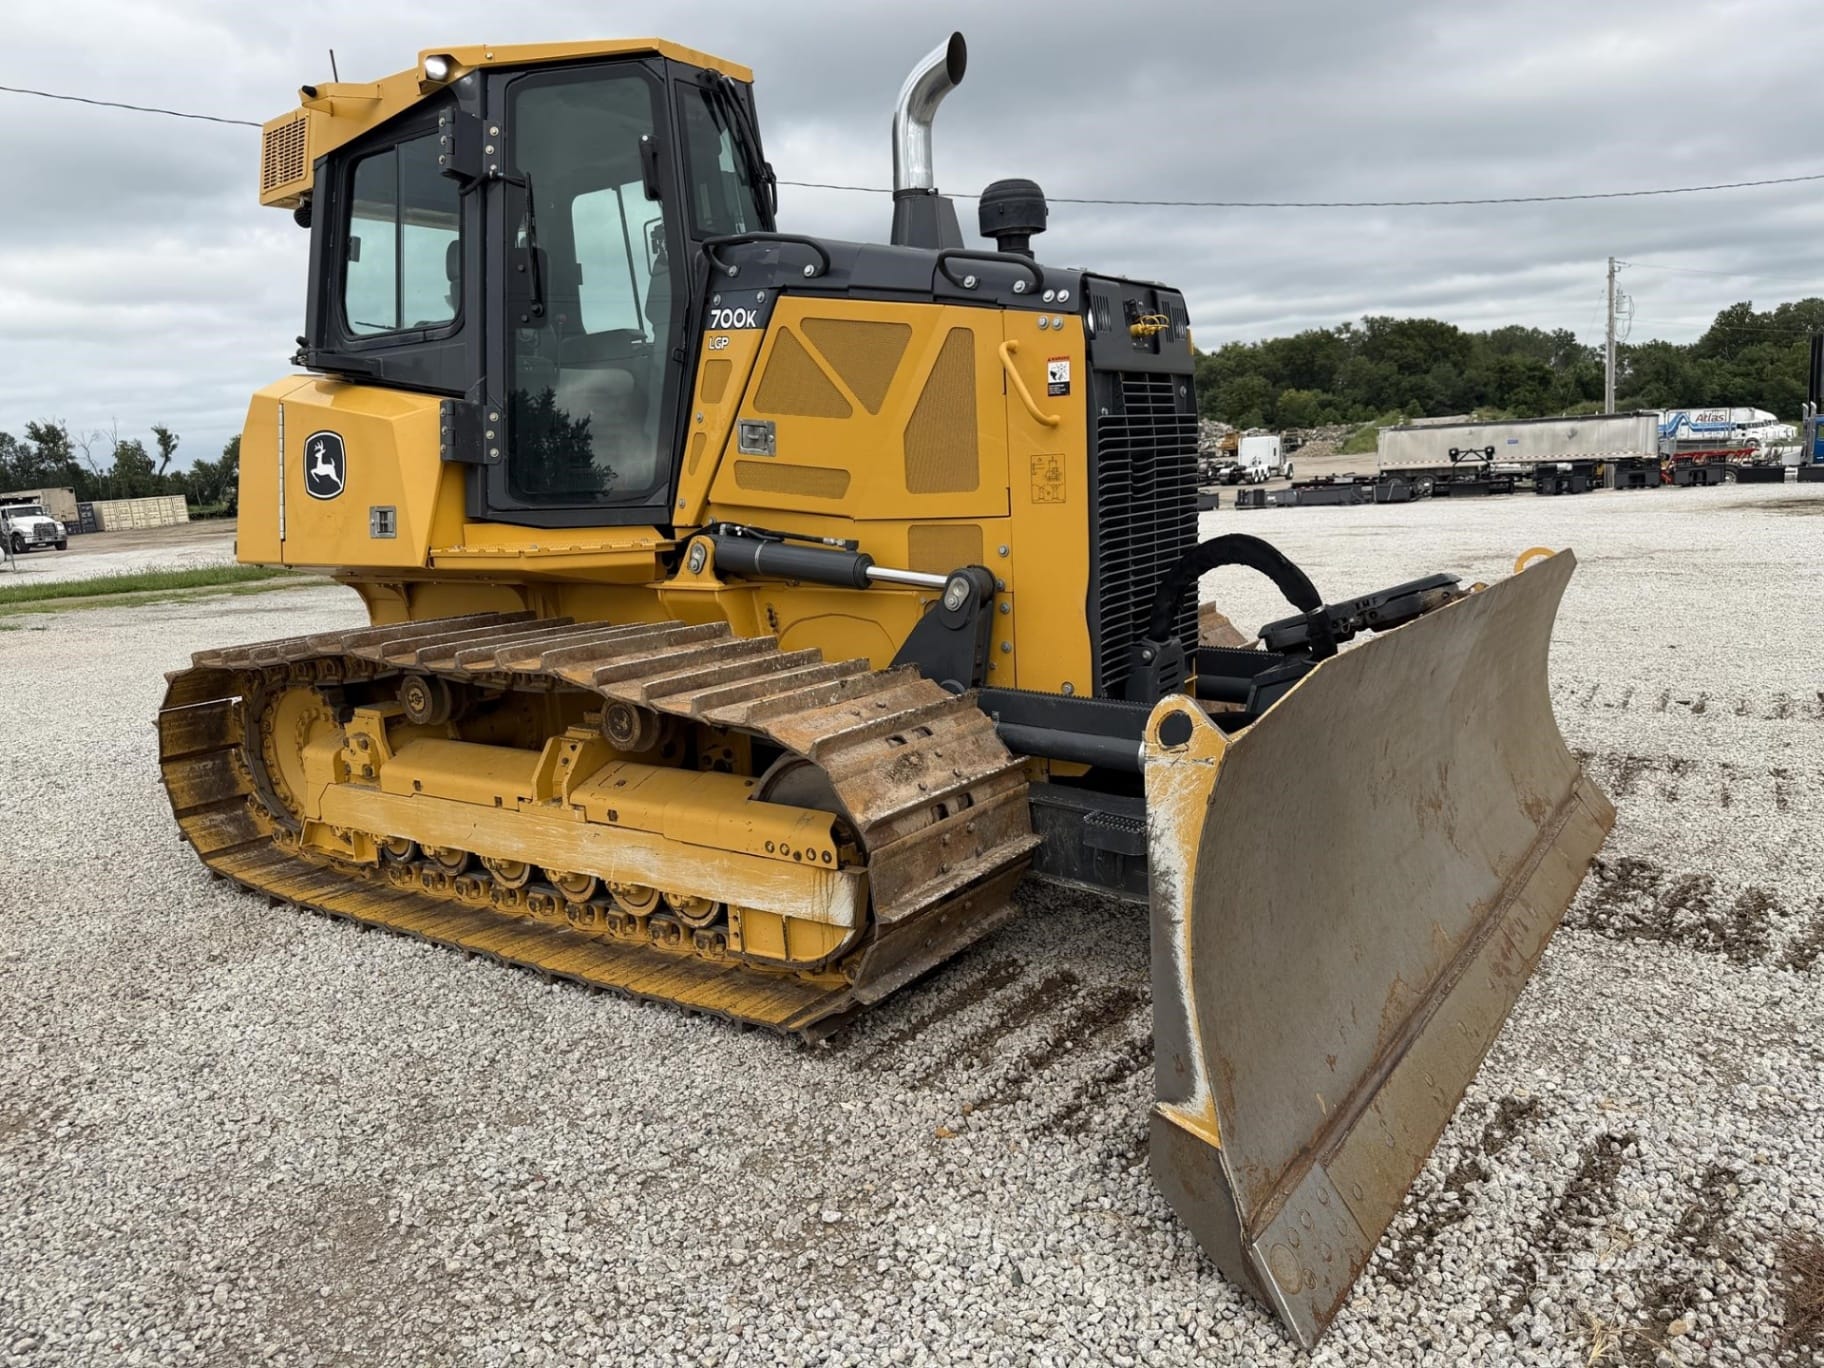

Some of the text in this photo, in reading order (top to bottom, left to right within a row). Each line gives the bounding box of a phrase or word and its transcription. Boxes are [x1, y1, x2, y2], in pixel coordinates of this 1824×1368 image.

[711, 308, 757, 329] 700K
[709, 336, 729, 350] LGP
[1695, 412, 1724, 422] Atlas
